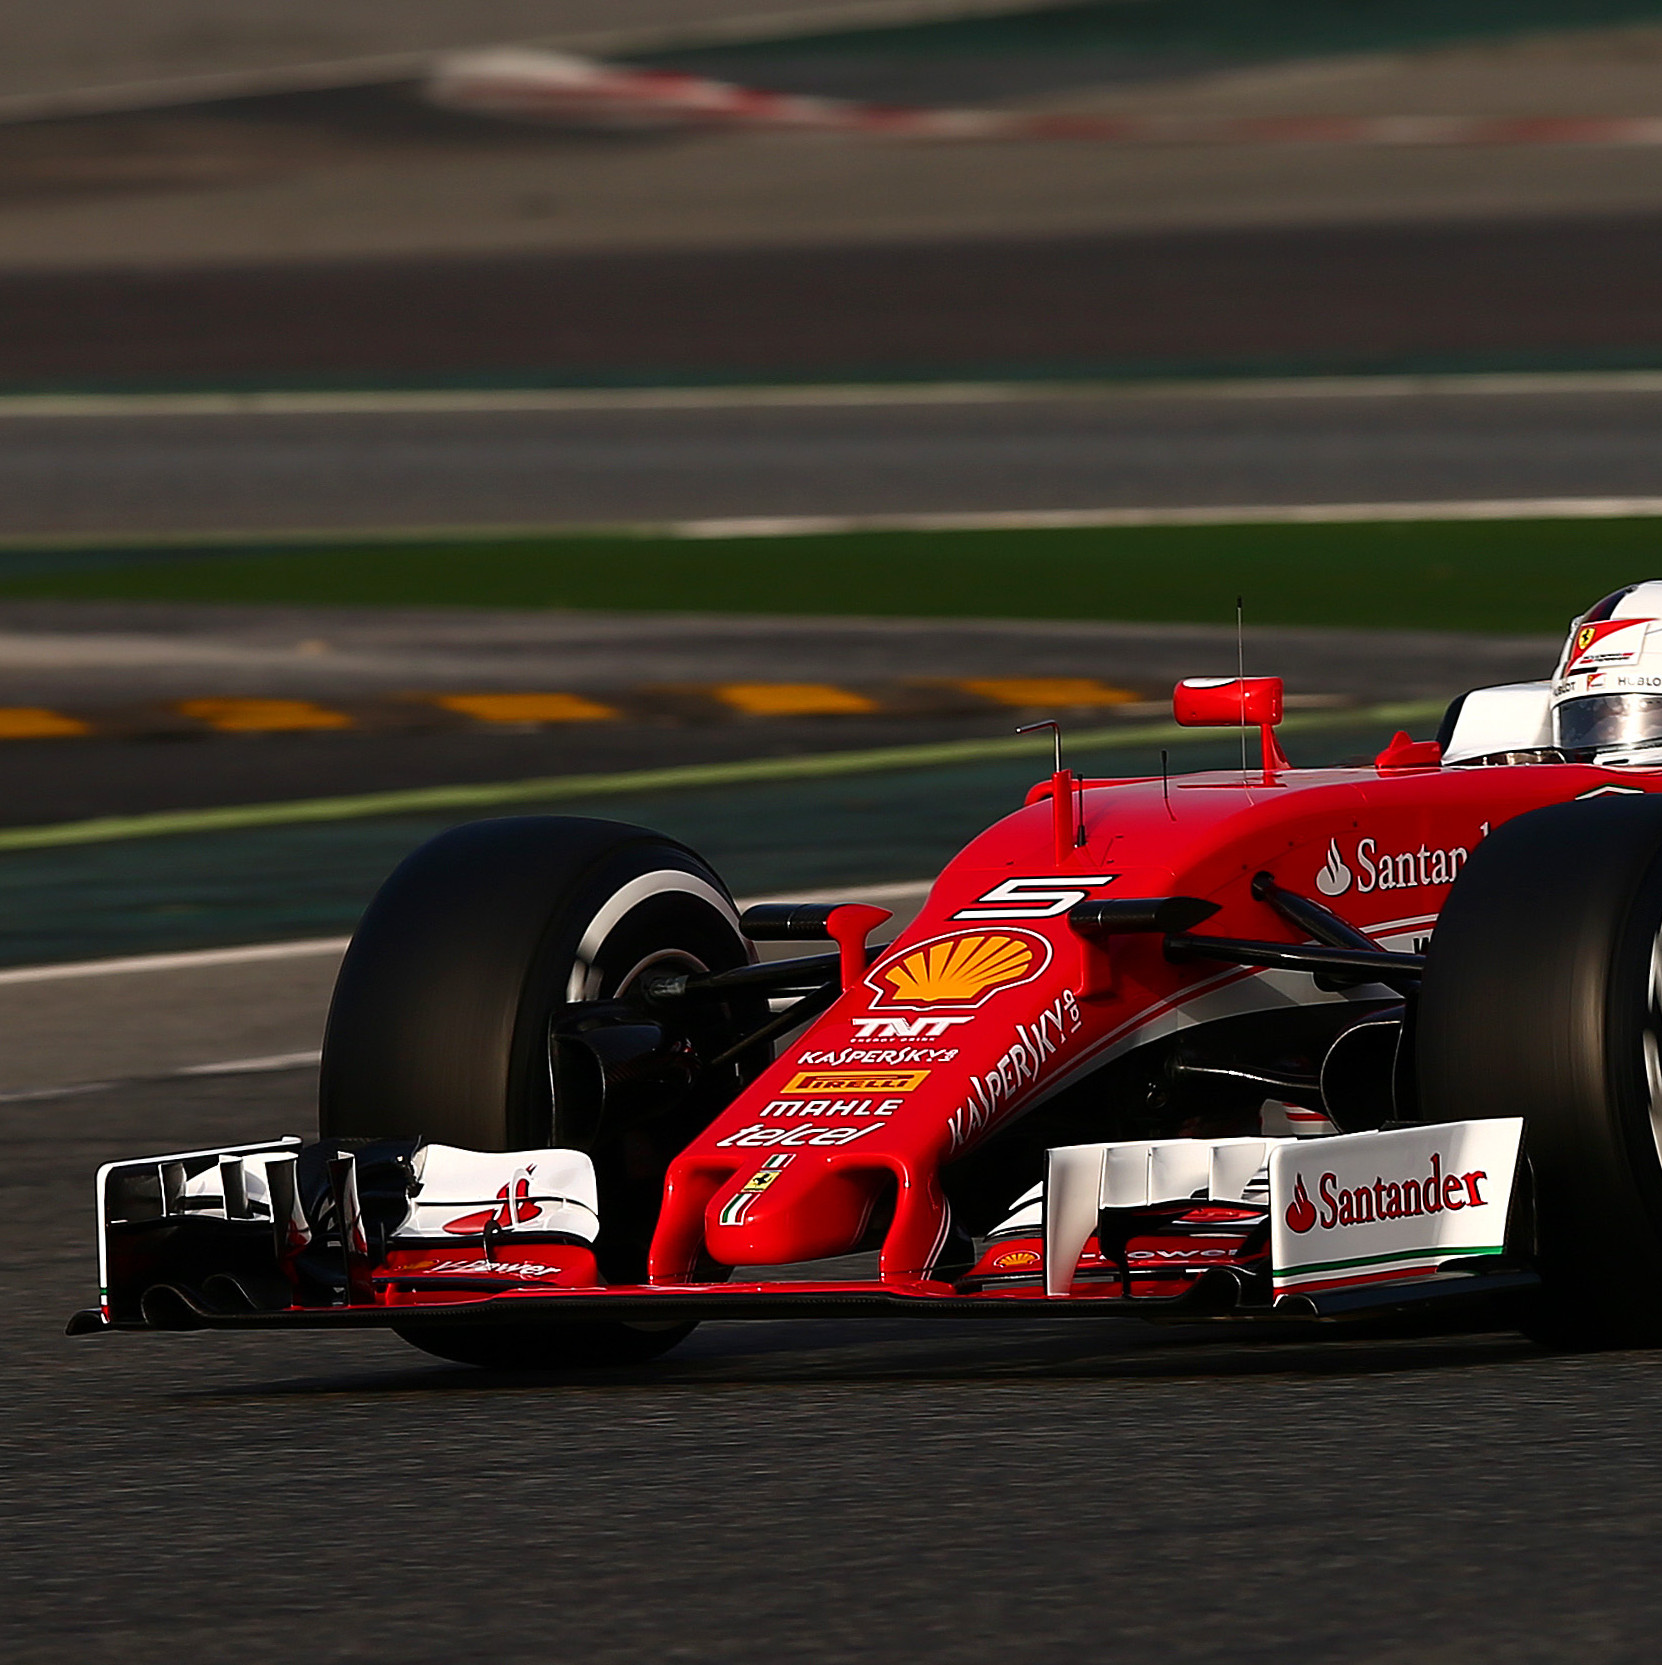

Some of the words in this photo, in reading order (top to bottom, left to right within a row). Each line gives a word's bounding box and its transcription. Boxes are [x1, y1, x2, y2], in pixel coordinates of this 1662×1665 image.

[1357, 822, 1490, 893] Santan
[949, 875, 1117, 920] 5
[852, 1015, 976, 1038] TNT
[797, 1046, 942, 1067] KASPERSKY
[795, 1074, 916, 1090] PIRELLI
[947, 998, 1067, 1155] KASPERSKY
[759, 1099, 904, 1117] MAHLE
[716, 1121, 886, 1147] telcel
[1318, 1151, 1489, 1230] Santander
